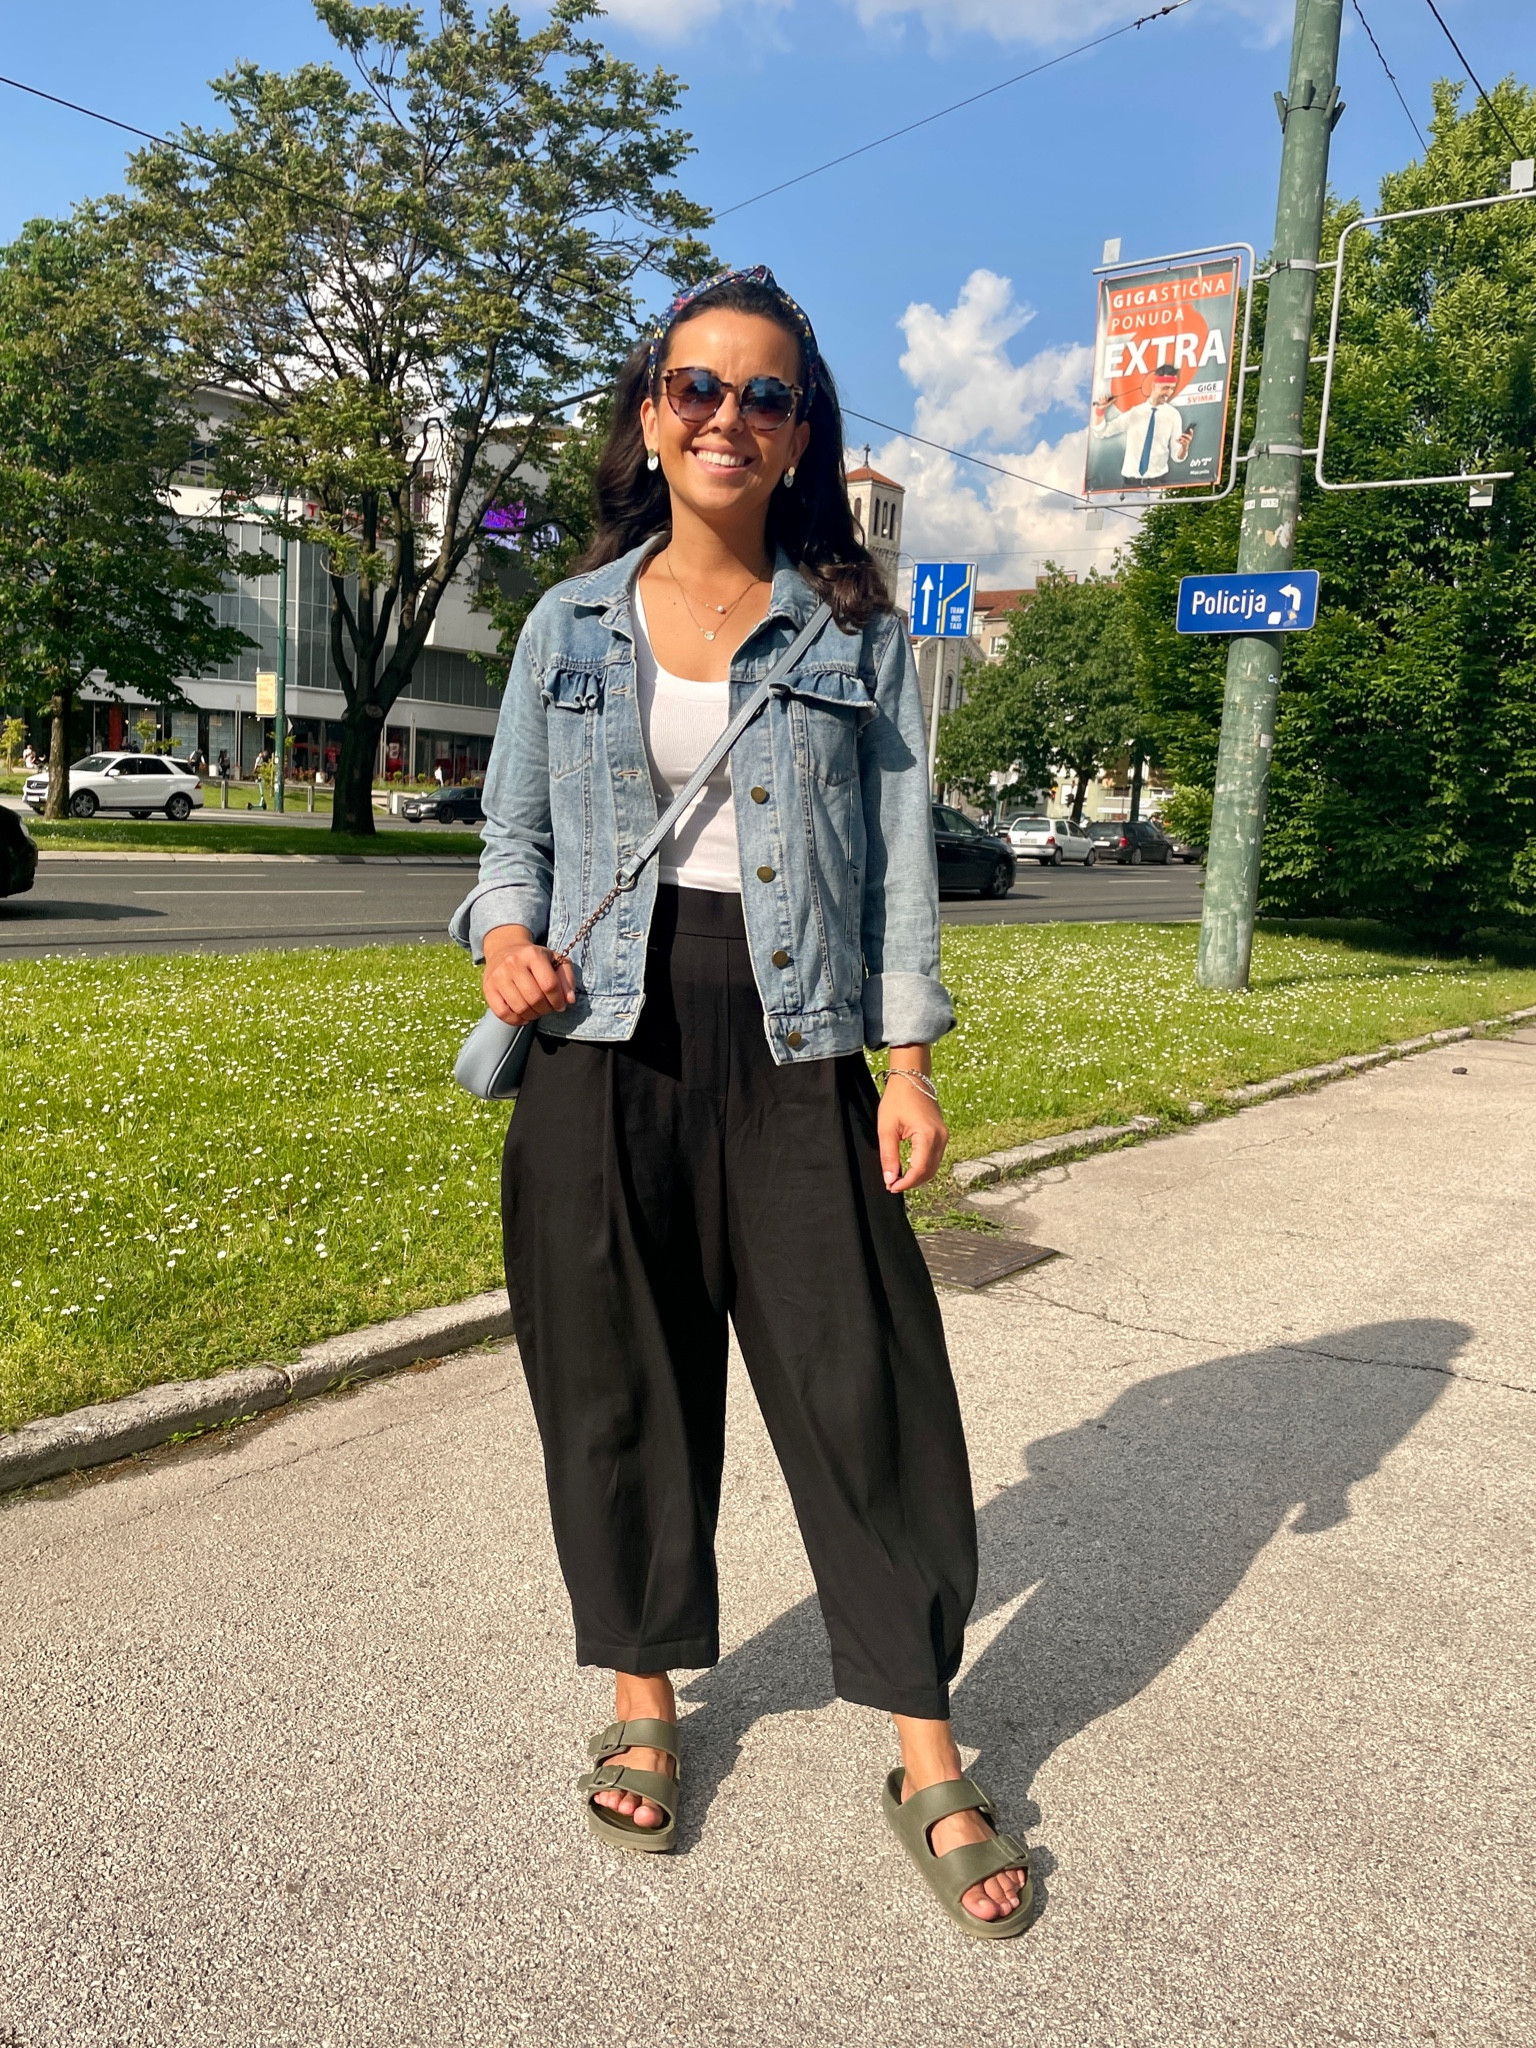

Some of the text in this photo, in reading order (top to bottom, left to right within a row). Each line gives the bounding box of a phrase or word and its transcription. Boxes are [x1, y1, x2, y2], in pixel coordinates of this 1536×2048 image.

[1113, 279, 1225, 308] GIGASTIČNA
[1112, 309, 1184, 331] PONUDA
[1103, 329, 1226, 378] EXTRA
[1187, 394, 1216, 405] SVIMA!
[1197, 382, 1217, 392] GIGE
[1191, 589, 1267, 620] Policija
